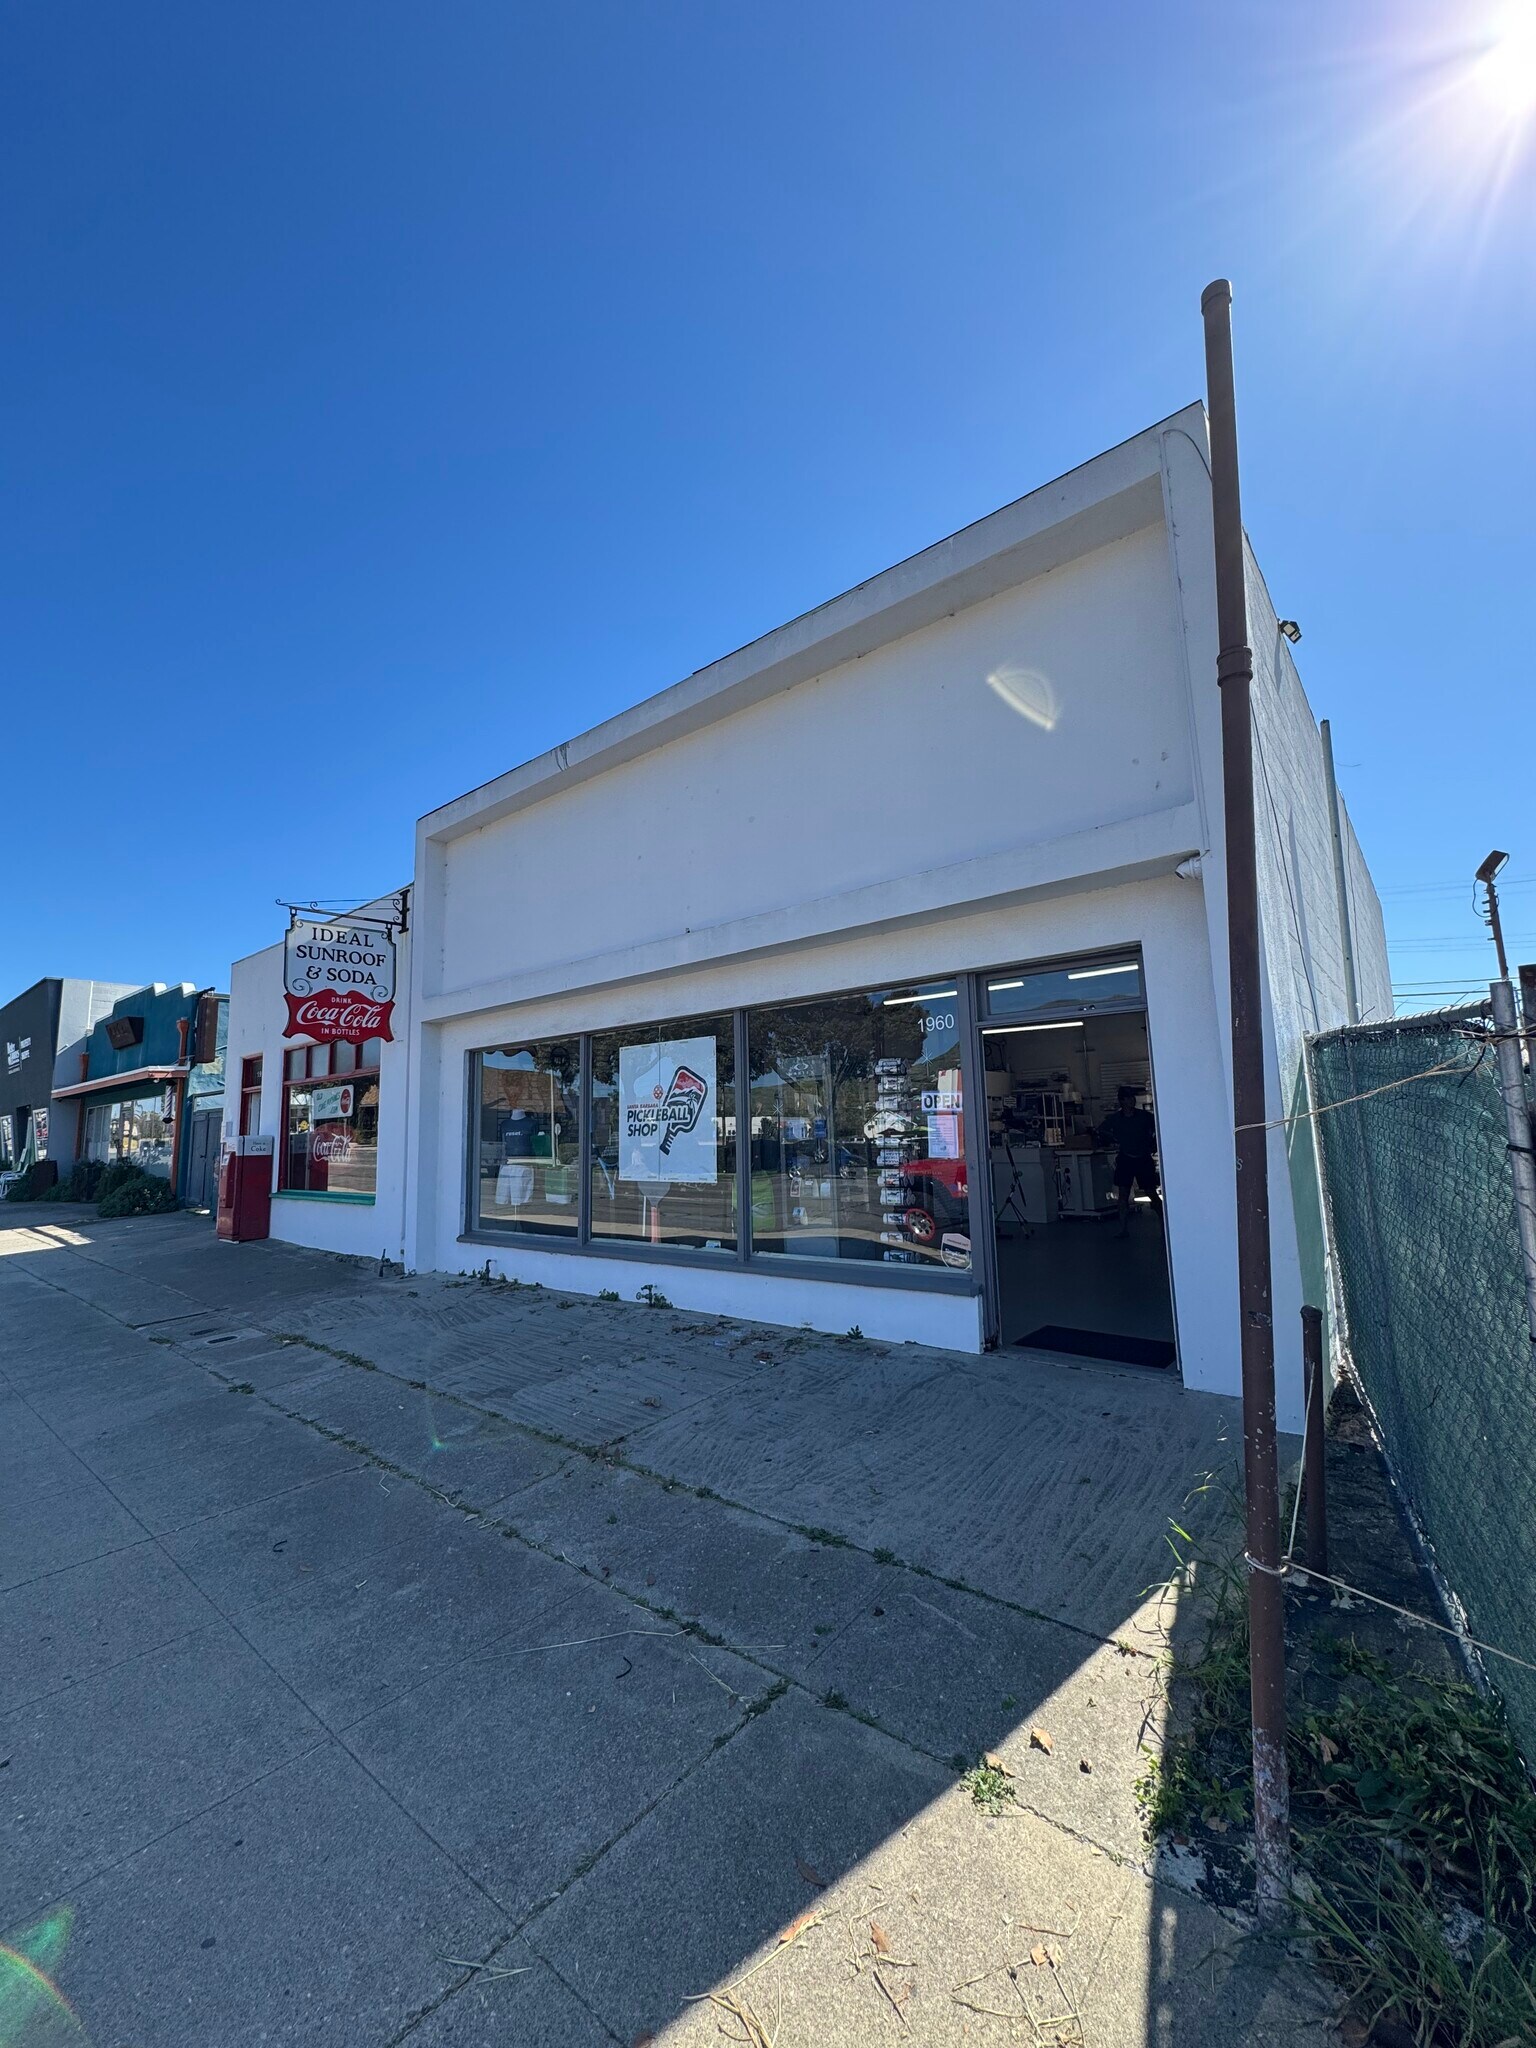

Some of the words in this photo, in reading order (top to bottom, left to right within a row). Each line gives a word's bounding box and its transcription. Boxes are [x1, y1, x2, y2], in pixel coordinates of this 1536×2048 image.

[312, 927, 374, 948] IDEAL
[296, 944, 386, 967] SUNROOF
[306, 965, 322, 980] &
[326, 967, 377, 985] SODA
[331, 996, 352, 1004] DRINK
[296, 1000, 384, 1028] Coca-Cola
[917, 1013, 955, 1032] 1960
[321, 1027, 330, 1035] IN
[331, 1028, 360, 1036] BOTTLES
[923, 1094, 961, 1109] OPEN
[627, 1106, 688, 1122] PICKLEBALL
[627, 1123, 658, 1137] SHOP
